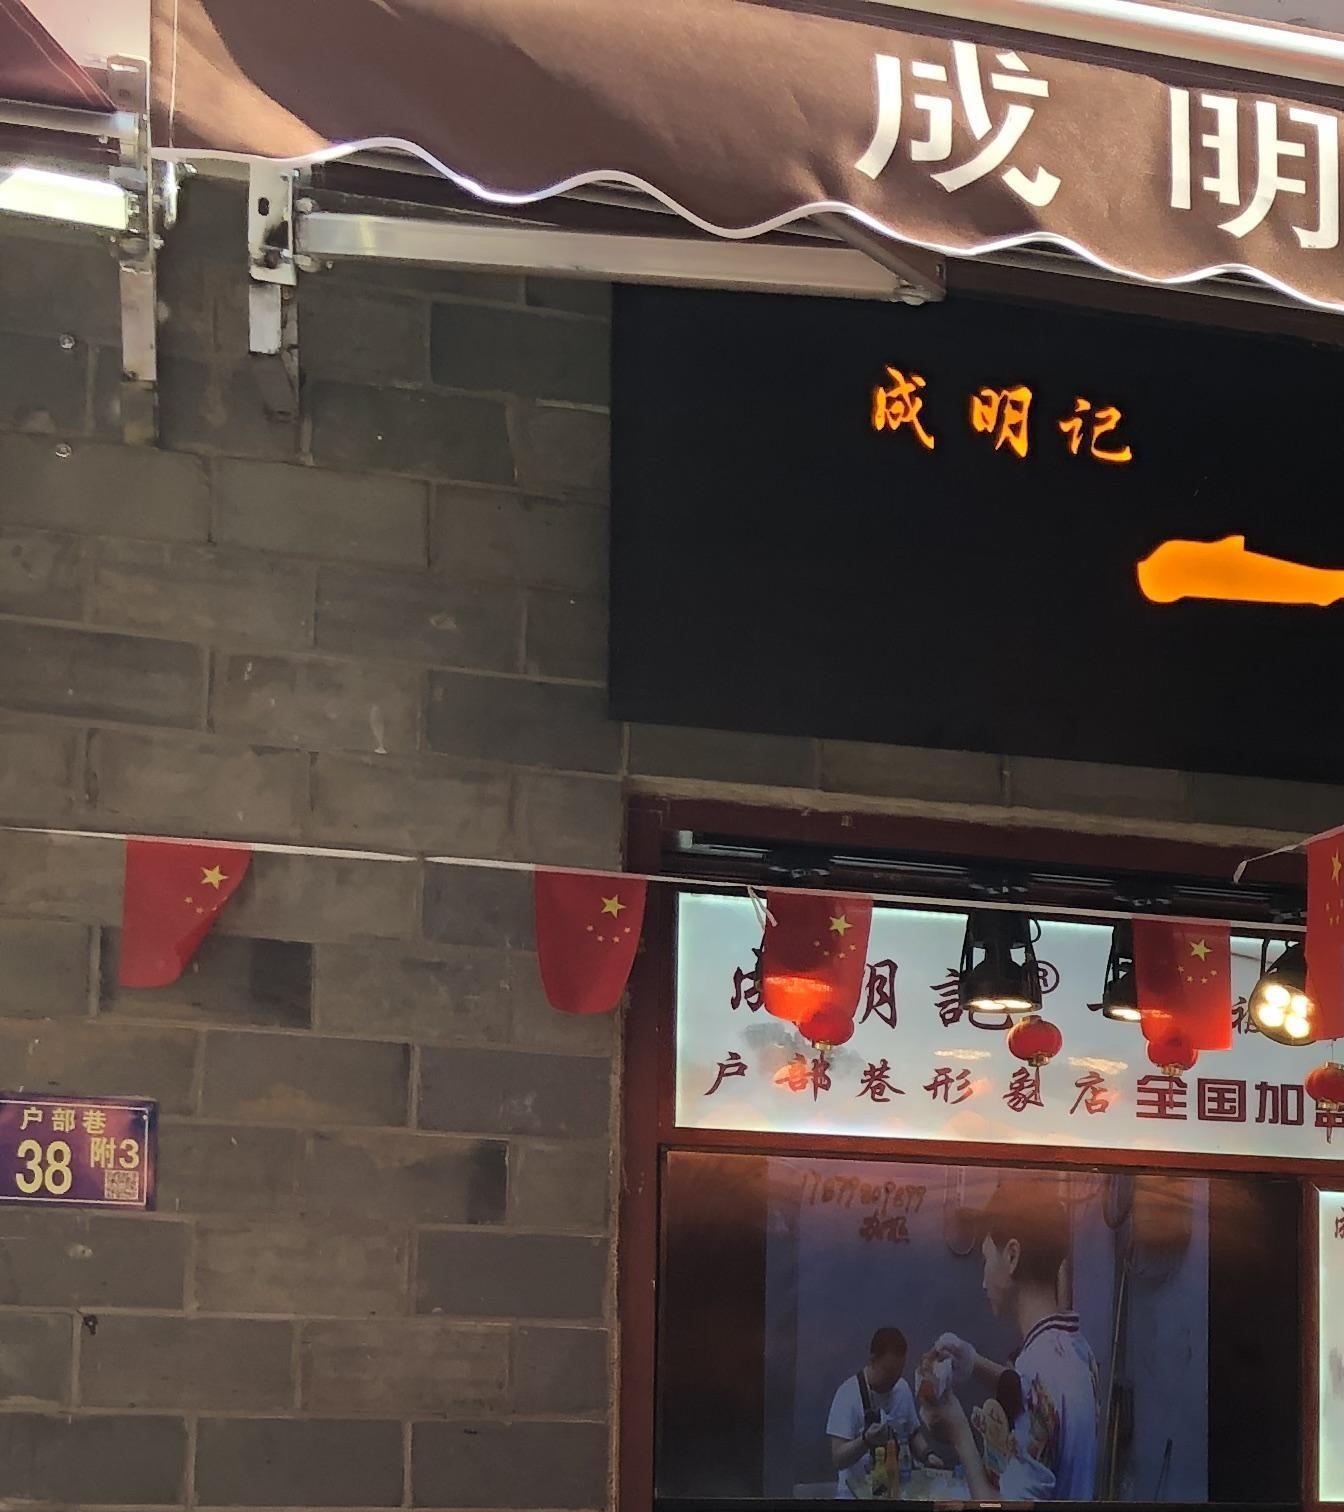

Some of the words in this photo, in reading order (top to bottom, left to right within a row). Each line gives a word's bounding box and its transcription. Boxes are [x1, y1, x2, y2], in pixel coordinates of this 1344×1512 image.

[873, 366, 1132, 461] 成明记
[705, 1051, 1113, 1116] 户部巷形象店
[20, 1107, 106, 1134] 户部巷
[16, 1139, 72, 1194] 38
